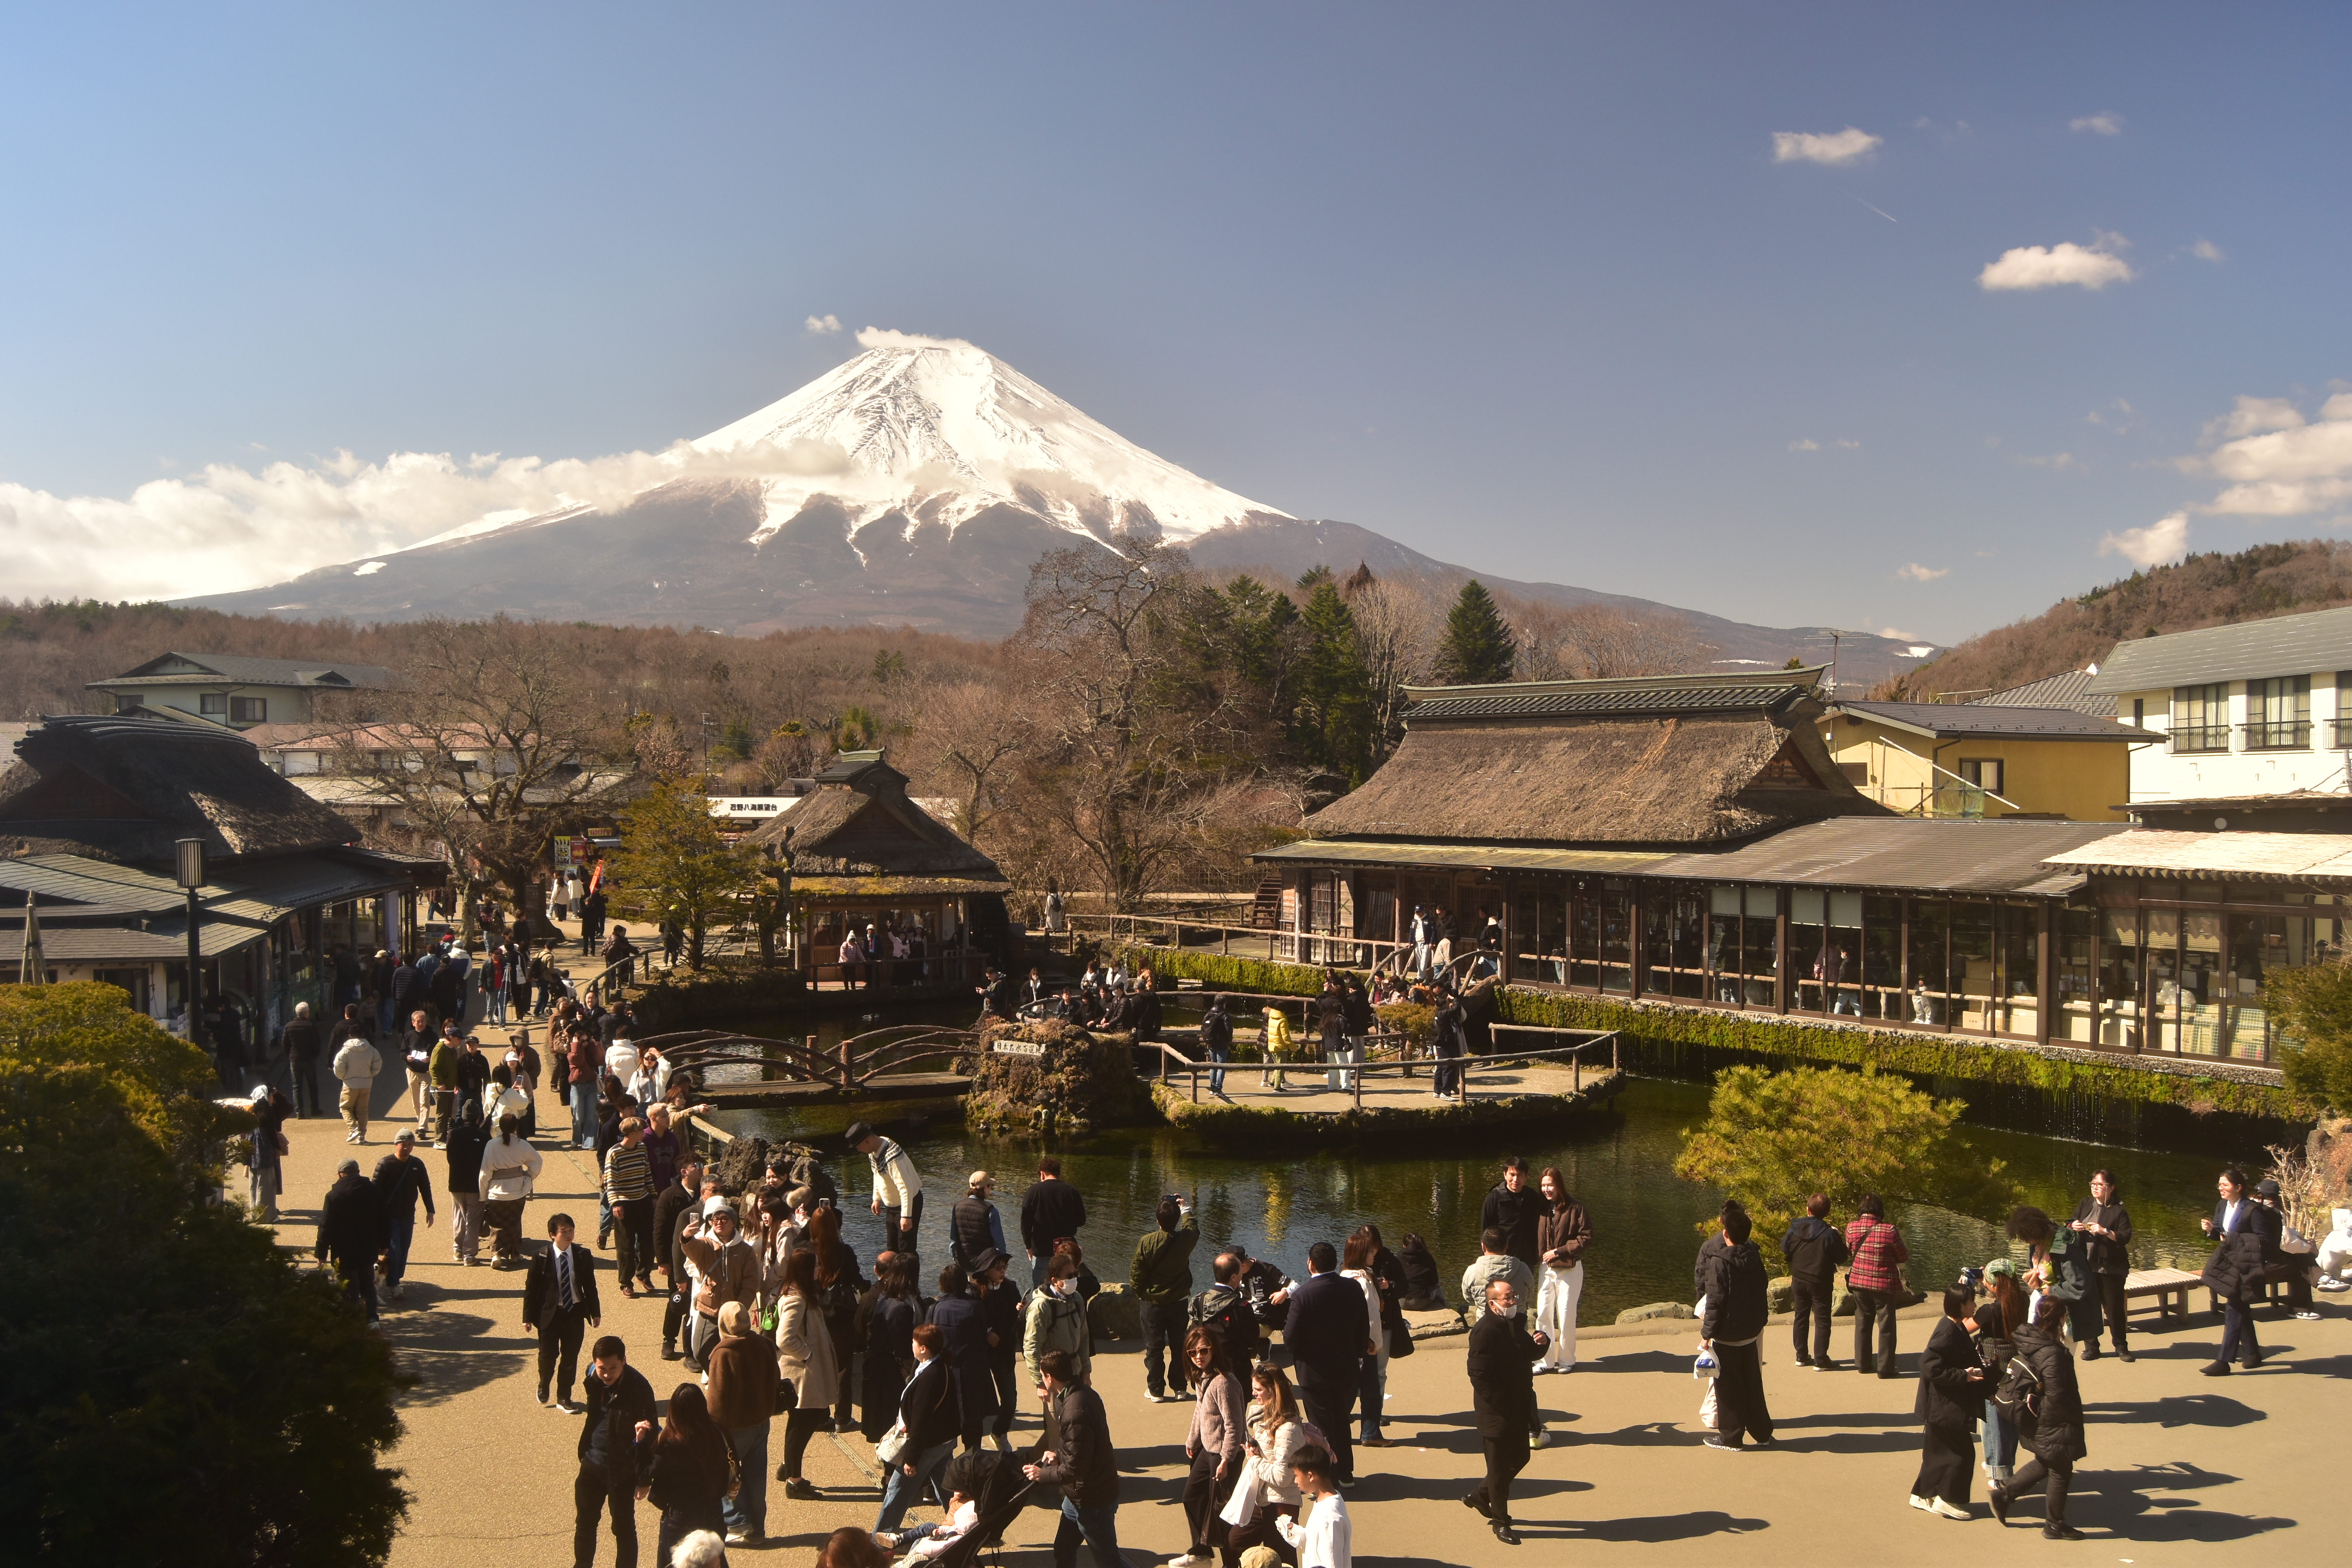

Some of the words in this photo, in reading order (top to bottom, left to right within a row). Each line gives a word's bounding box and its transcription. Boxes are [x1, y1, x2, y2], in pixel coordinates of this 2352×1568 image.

[997, 1042, 1042, 1053] 日本名水百選地
